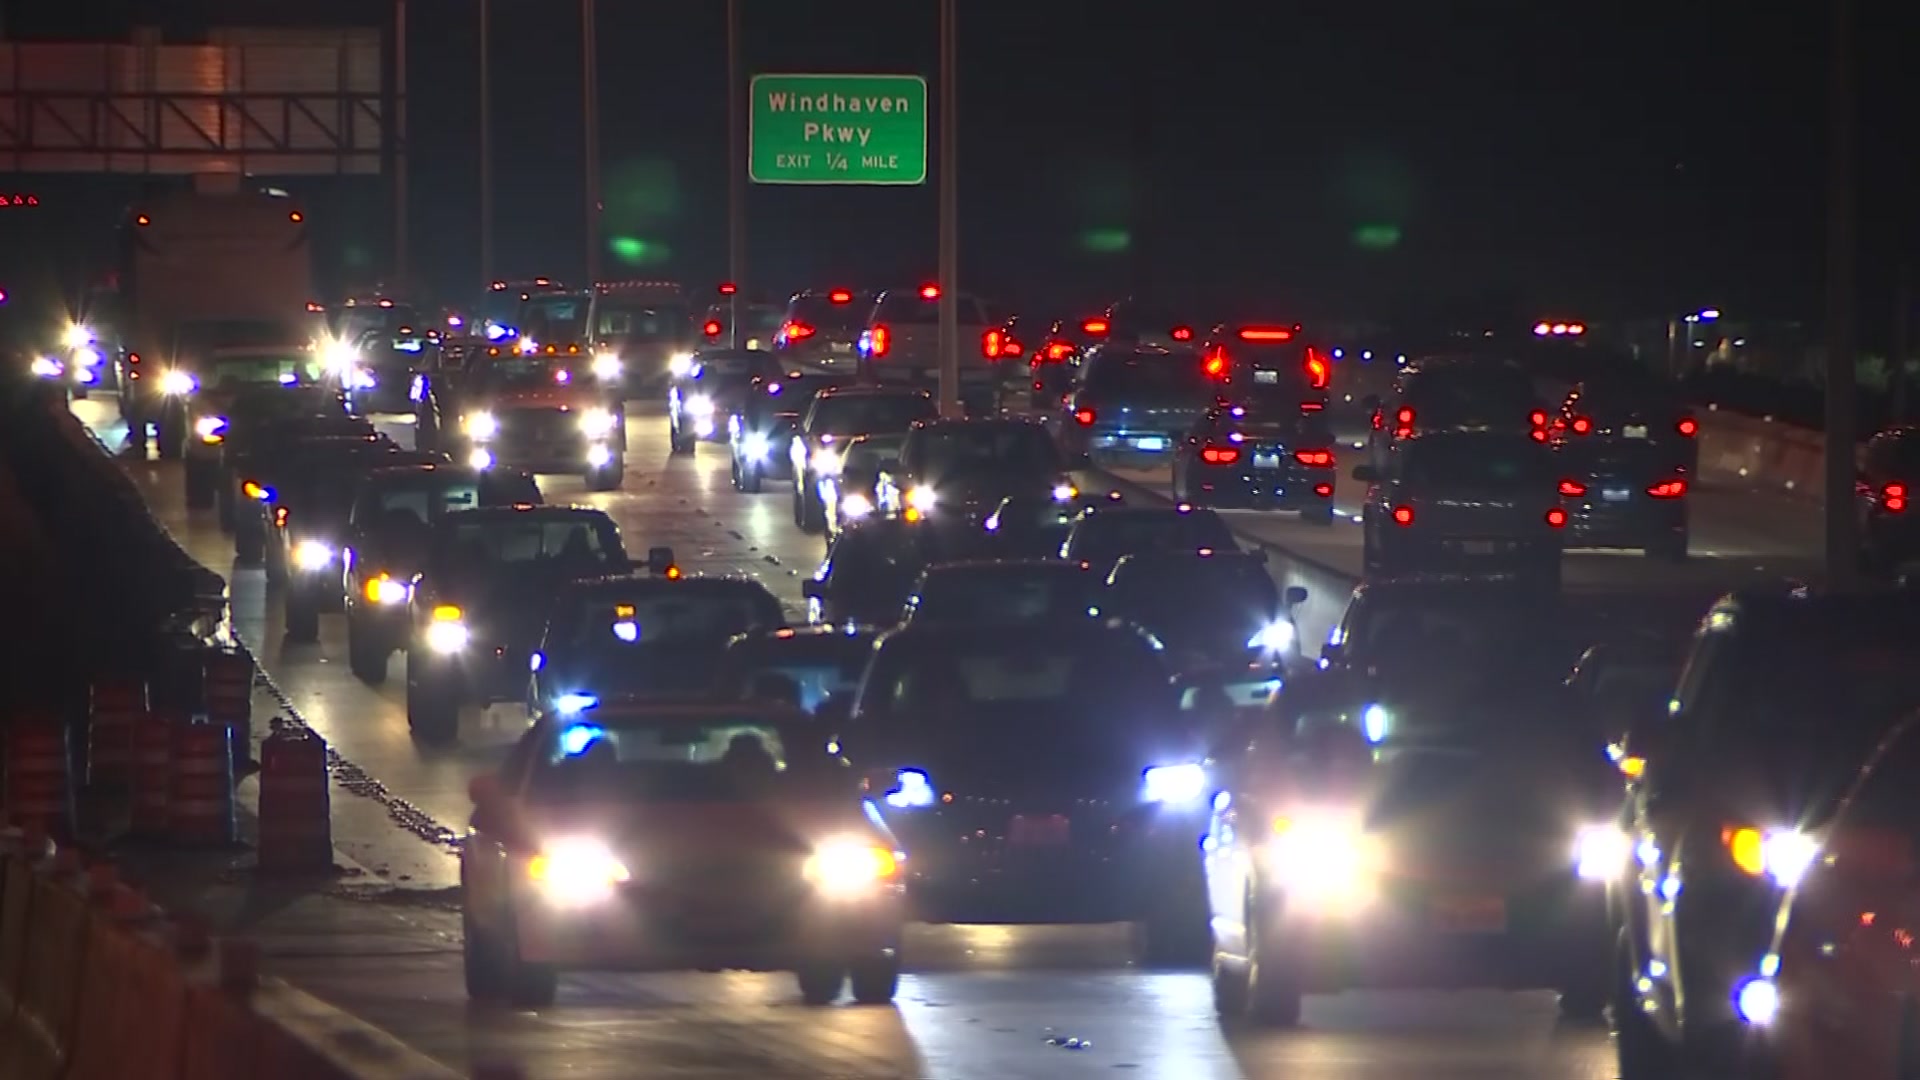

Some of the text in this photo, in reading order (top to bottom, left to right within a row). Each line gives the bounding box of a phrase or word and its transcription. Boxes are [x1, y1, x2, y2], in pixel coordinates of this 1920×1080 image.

[769, 92, 909, 113] Windhaven
[804, 122, 872, 146] Pkwy
[776, 155, 811, 168] EXIT
[862, 155, 898, 169] MILE
